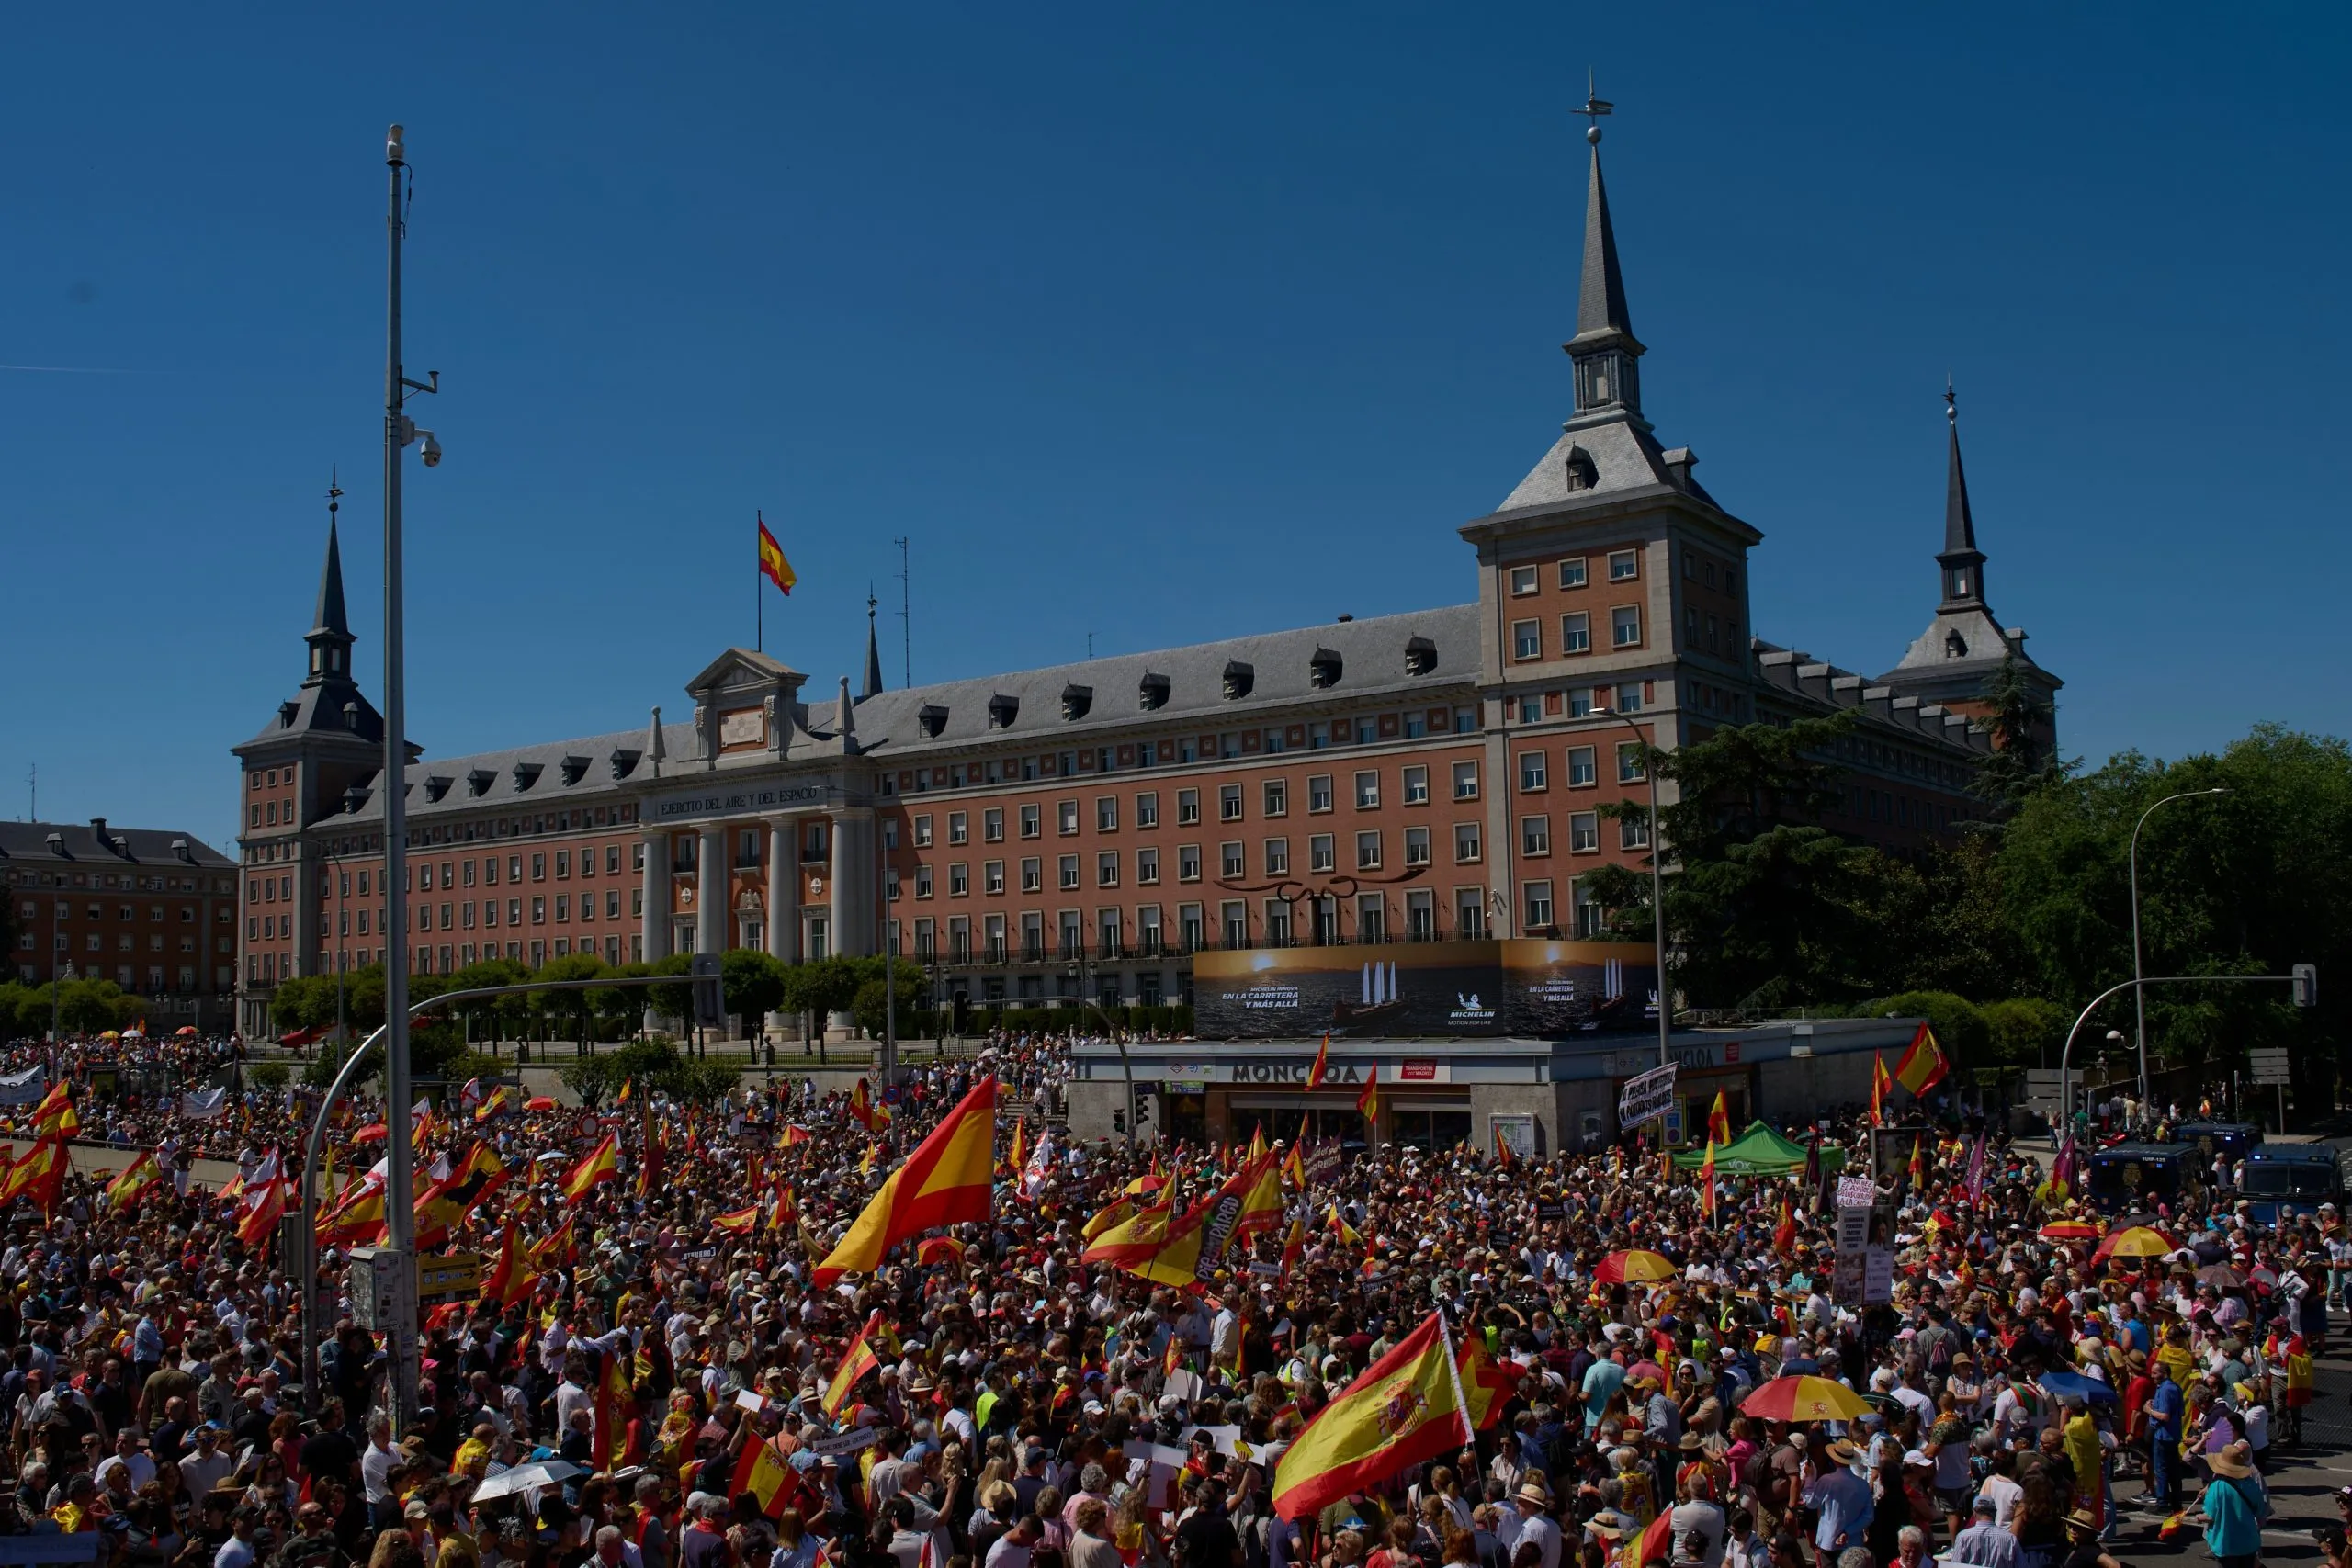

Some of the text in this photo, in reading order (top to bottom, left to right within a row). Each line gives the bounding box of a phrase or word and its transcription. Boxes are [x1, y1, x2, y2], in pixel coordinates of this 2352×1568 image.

[705, 798, 722, 810] DEL
[725, 795, 746, 808] AIRE
[748, 794, 755, 806] Y
[758, 792, 775, 804] DEL
[779, 787, 817, 802] ESPACIO
[1252, 999, 1273, 1008] MÁS
[1274, 999, 1298, 1008] ALLÁ
[1655, 1048, 1713, 1069] MNCLOA
[1232, 1063, 1360, 1083] MONCOA
[1728, 1159, 1751, 1170] VOX
